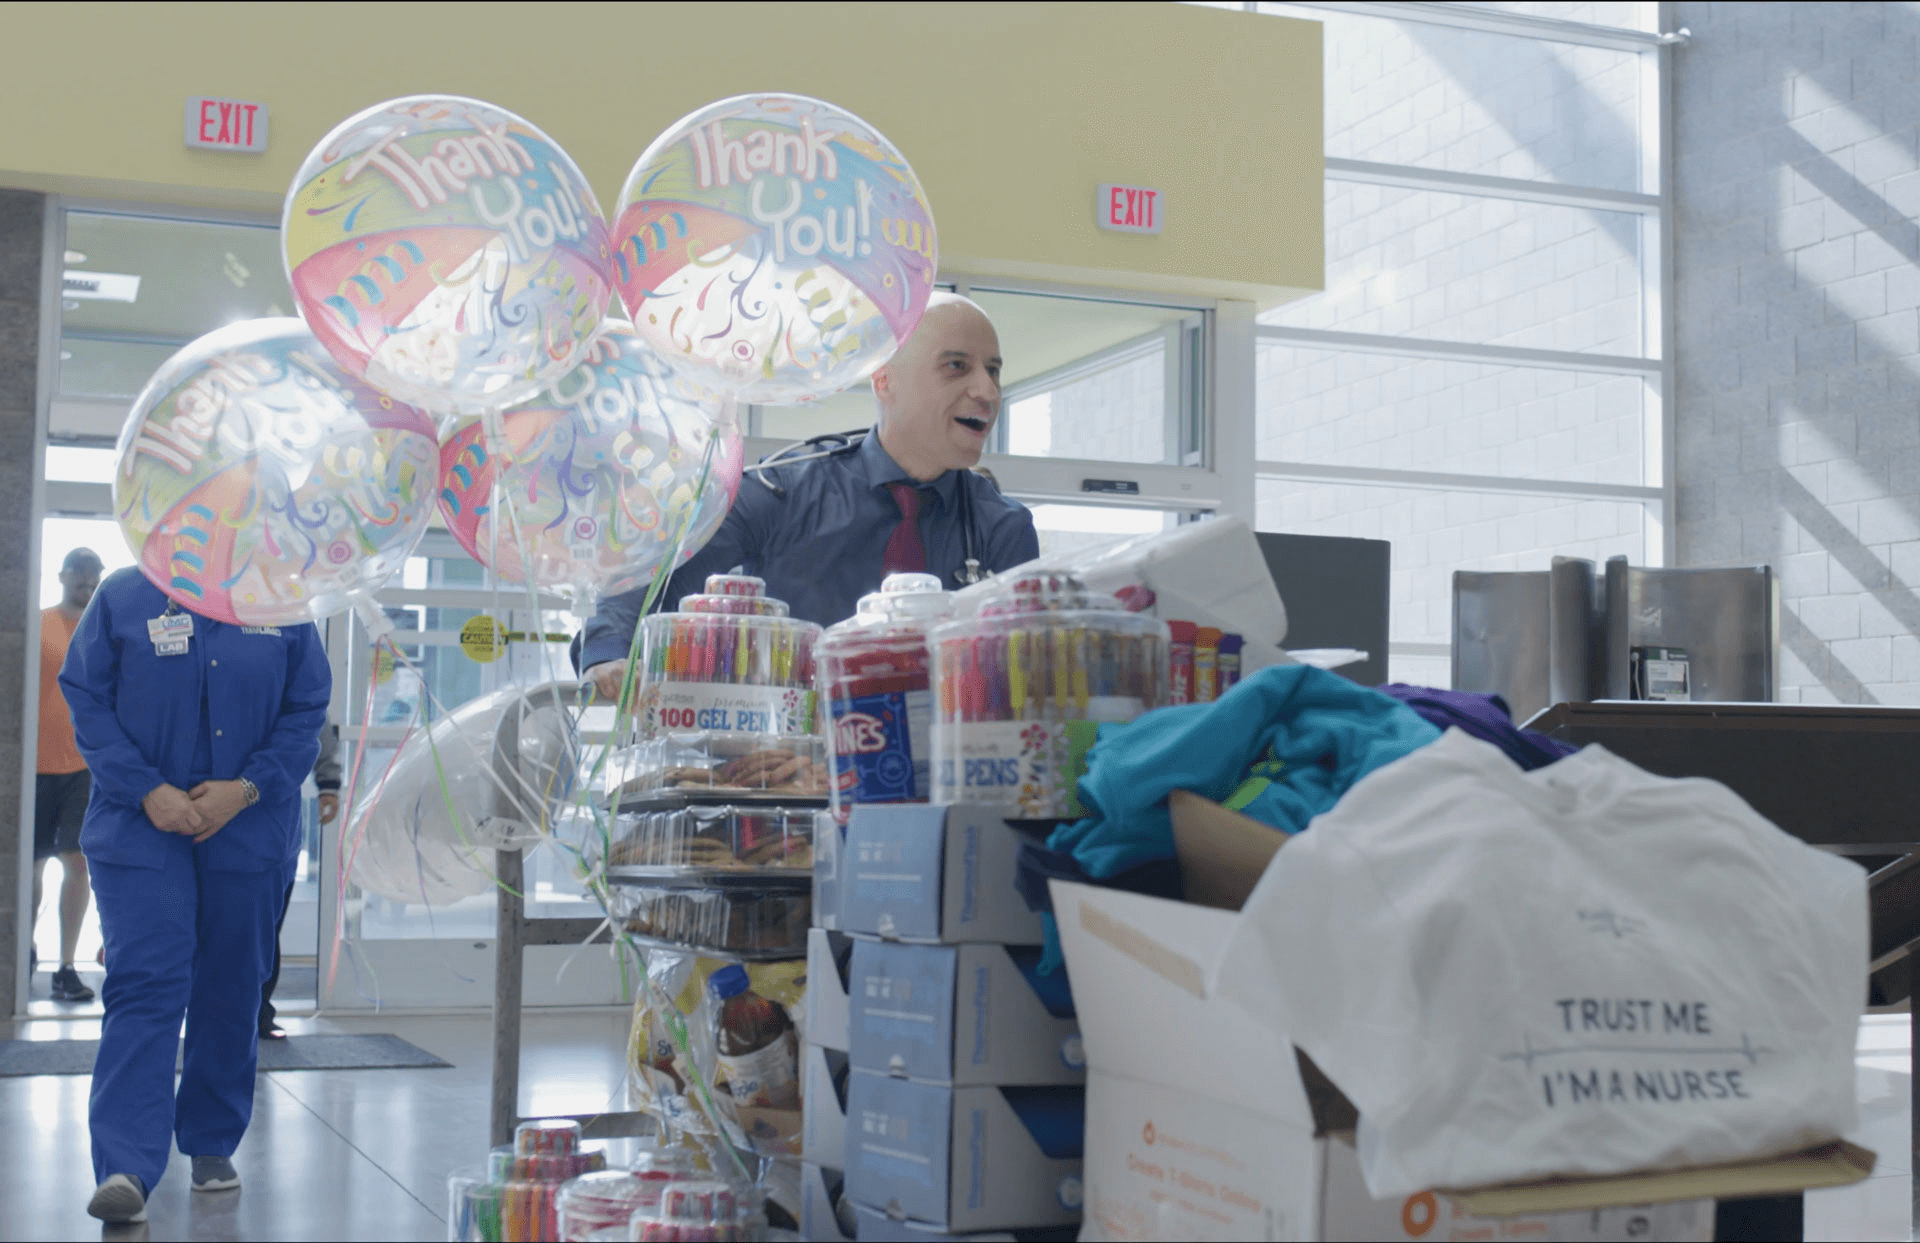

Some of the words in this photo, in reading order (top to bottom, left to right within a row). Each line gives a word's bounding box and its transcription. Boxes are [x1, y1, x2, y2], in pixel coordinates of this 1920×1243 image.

[199, 100, 259, 147] EXIT
[339, 112, 538, 212] Thank
[664, 110, 840, 190] Thank
[470, 175, 592, 263] You!
[751, 178, 875, 264] You!
[1110, 187, 1158, 228] EXIT
[159, 642, 184, 653] LAB
[659, 707, 696, 728] 100
[697, 708, 731, 730] GEL
[829, 713, 887, 756] INES
[964, 758, 1019, 786] PENS
[1554, 998, 1653, 1032] TRUST
[1662, 1001, 1712, 1035] ME
[1541, 1067, 1603, 1108] I'M
[1608, 1069, 1628, 1102] A
[1632, 1068, 1750, 1103] NURSE
